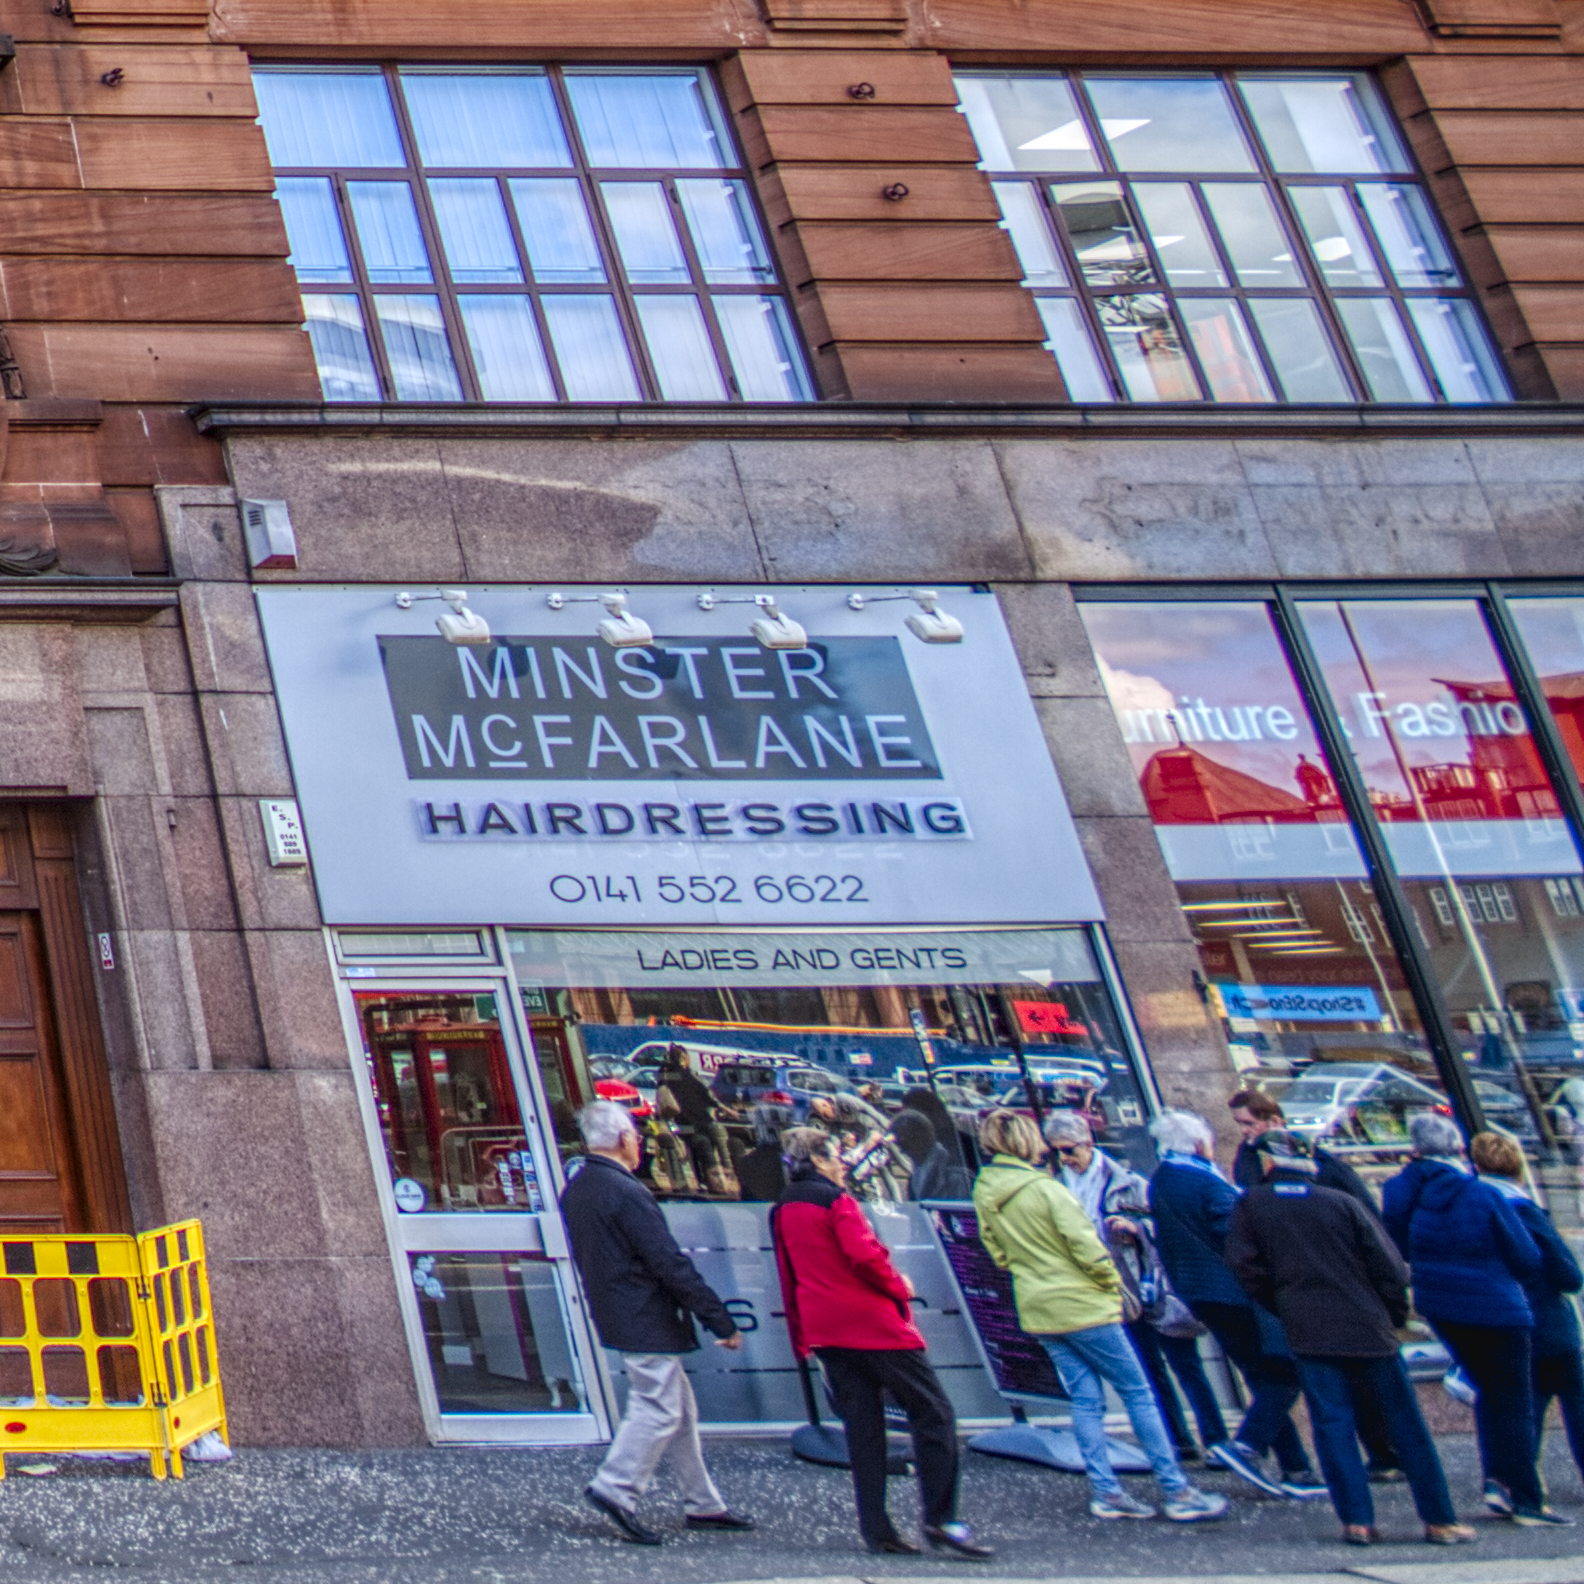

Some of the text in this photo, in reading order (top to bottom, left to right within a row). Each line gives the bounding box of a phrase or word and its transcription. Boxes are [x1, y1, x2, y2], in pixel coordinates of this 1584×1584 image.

[455, 646, 839, 700] MINSTER
[1358, 692, 1528, 737] Fashio
[425, 801, 967, 837] HAIRDRESSING
[549, 875, 869, 904] 0141 552 6622
[637, 948, 967, 971] LADIES AND GENTS
